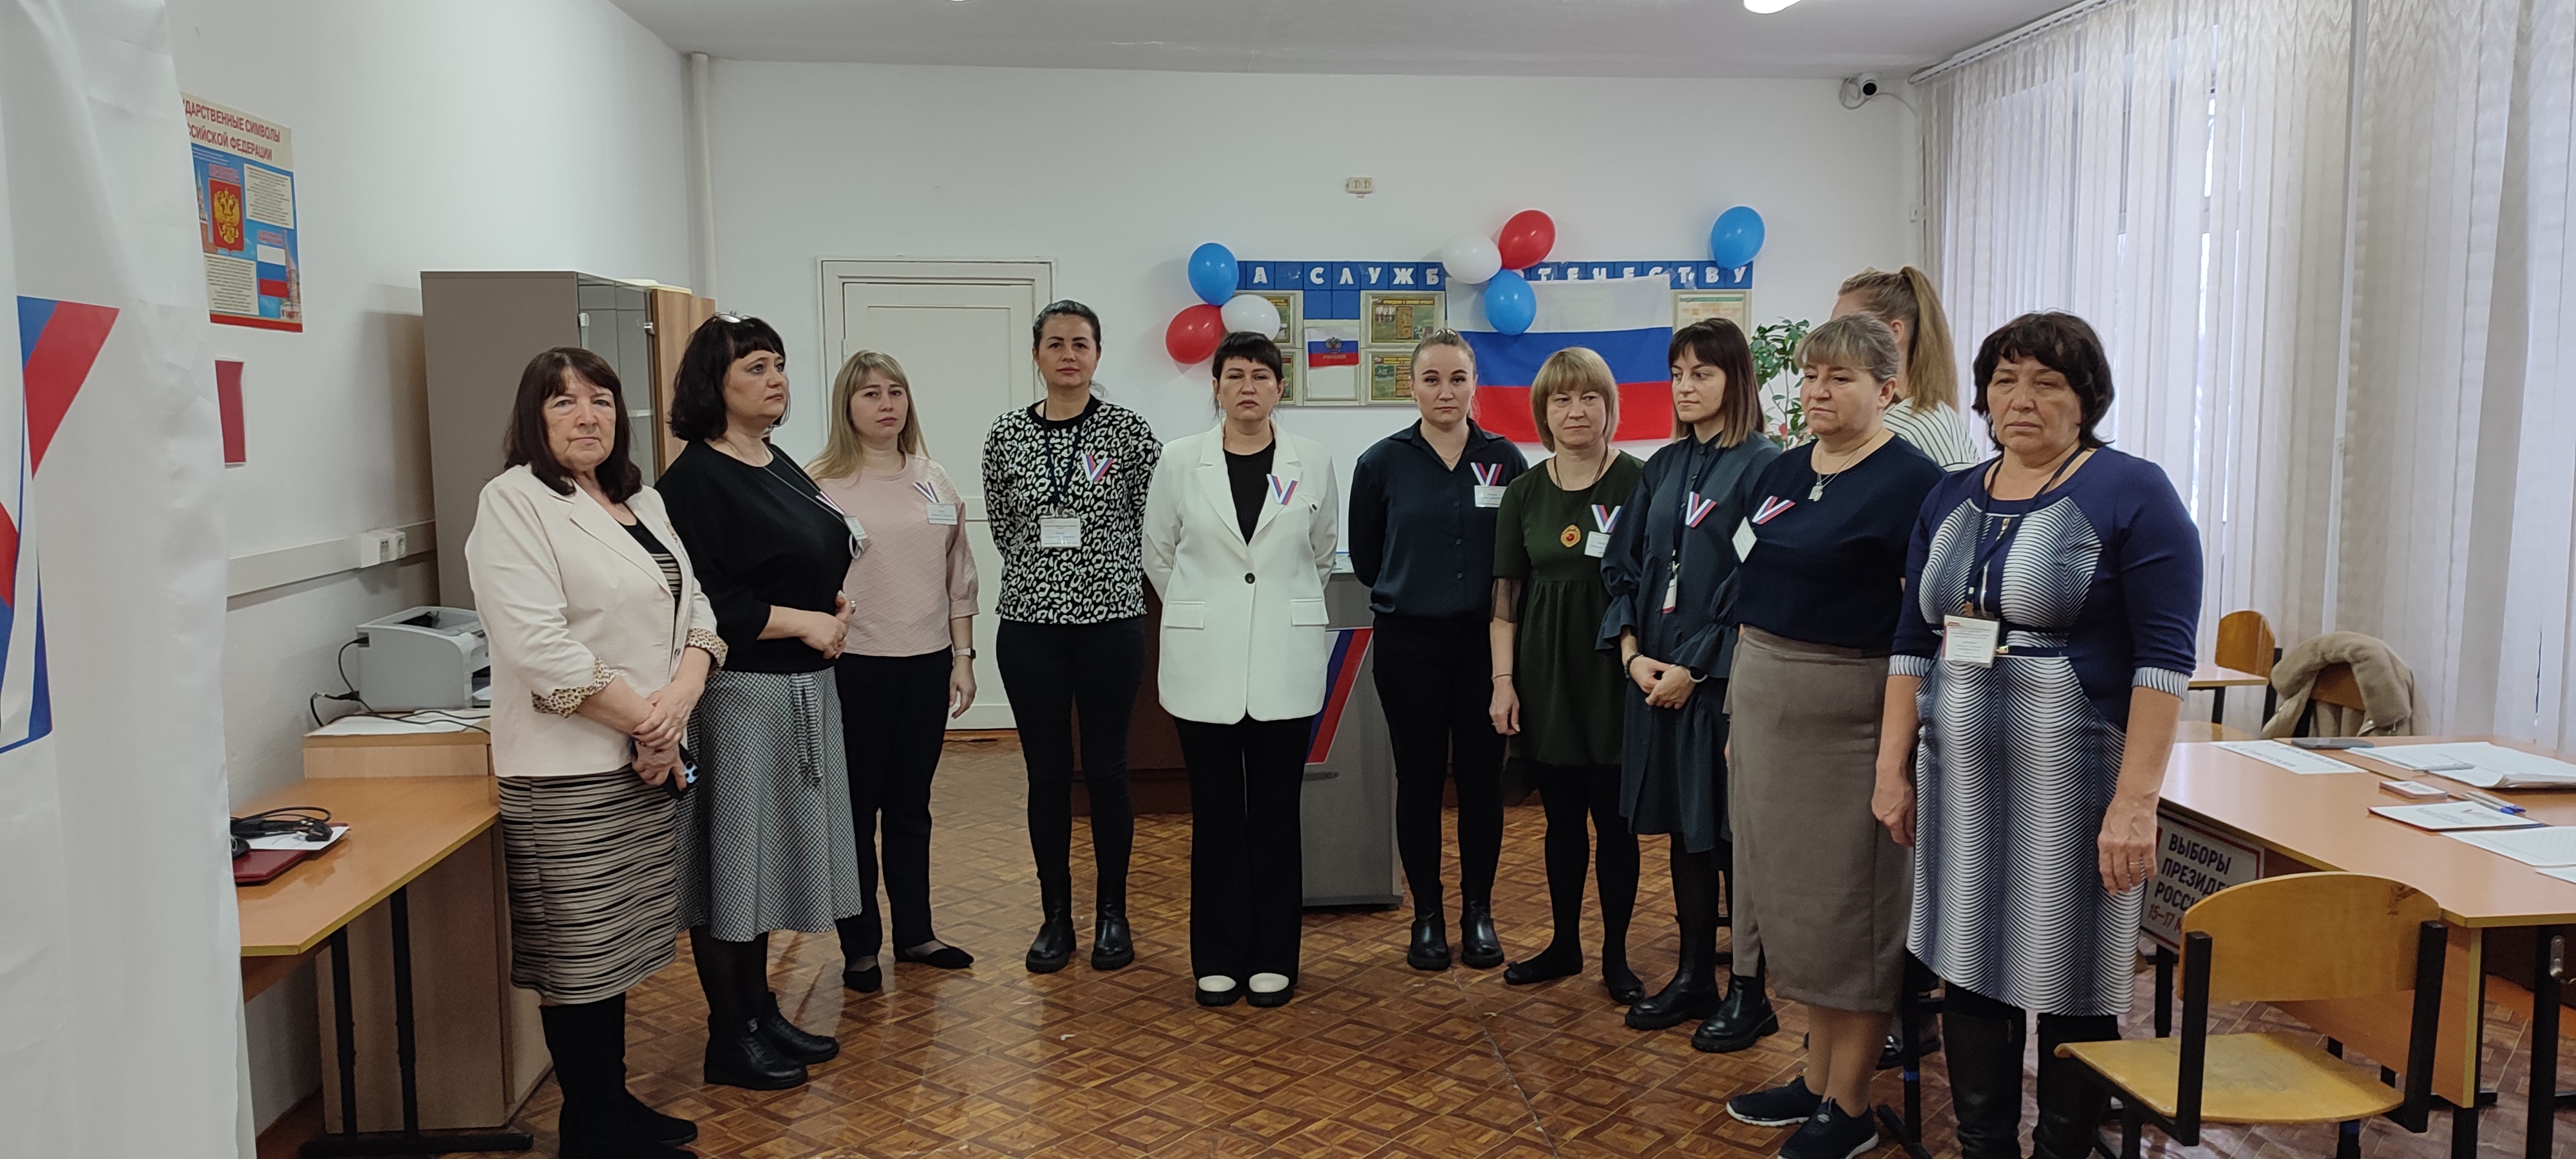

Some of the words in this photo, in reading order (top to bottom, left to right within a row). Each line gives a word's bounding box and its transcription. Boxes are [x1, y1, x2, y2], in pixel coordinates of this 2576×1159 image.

[183, 99, 244, 131] ДАРСТВЕННЫЕ
[245, 119, 280, 142] СИМВОЛЫ
[230, 137, 272, 161] ФЕДЕРАЦИИ
[1253, 267, 1268, 284] А
[1310, 267, 1439, 285] СЛУЖБ
[1520, 266, 1747, 284] ТЕЧЕСТВУ
[2168, 833, 2231, 874] ВЫБОРЫ
[2161, 857, 2231, 896] ПРЕЗИДЕ
